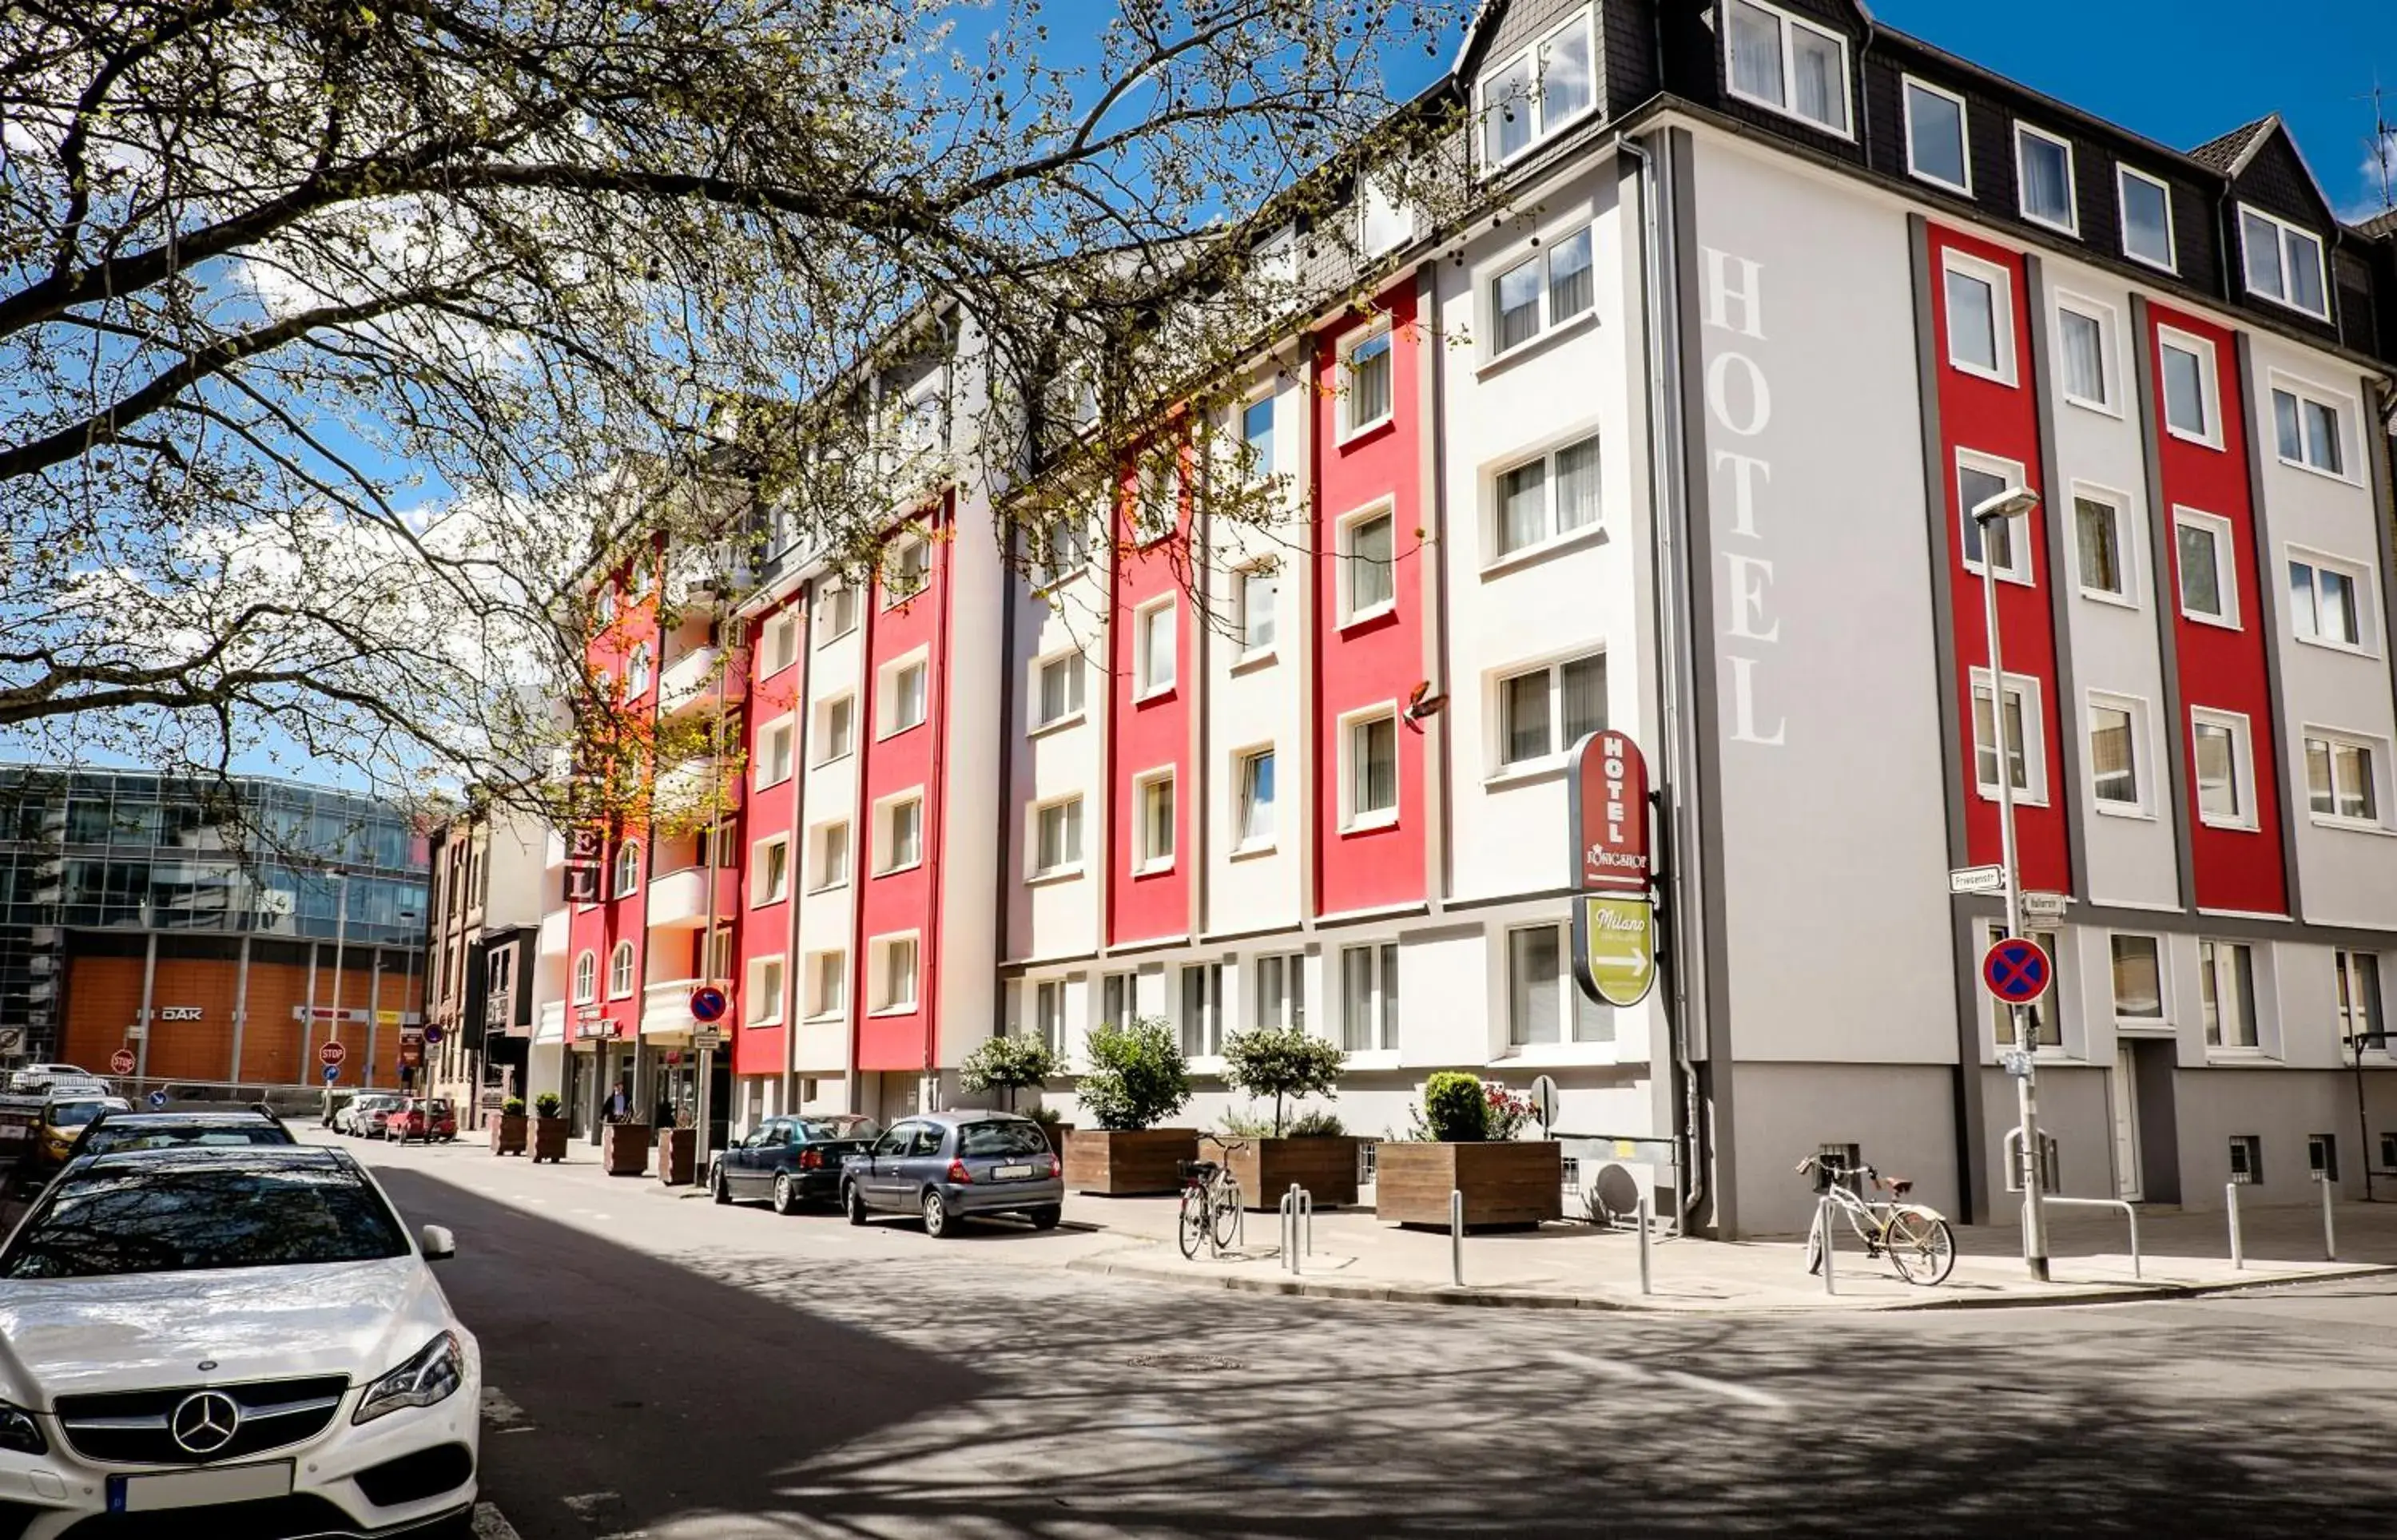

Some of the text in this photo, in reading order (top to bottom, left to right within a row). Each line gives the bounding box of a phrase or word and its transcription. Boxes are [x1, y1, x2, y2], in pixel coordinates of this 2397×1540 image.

[1700, 245, 1786, 745] HOTEL
[1604, 736, 1624, 843] HOTEL
[1596, 907, 1645, 931] Milano
[162, 1006, 203, 1020] DAK
[322, 1049, 343, 1058] STOP
